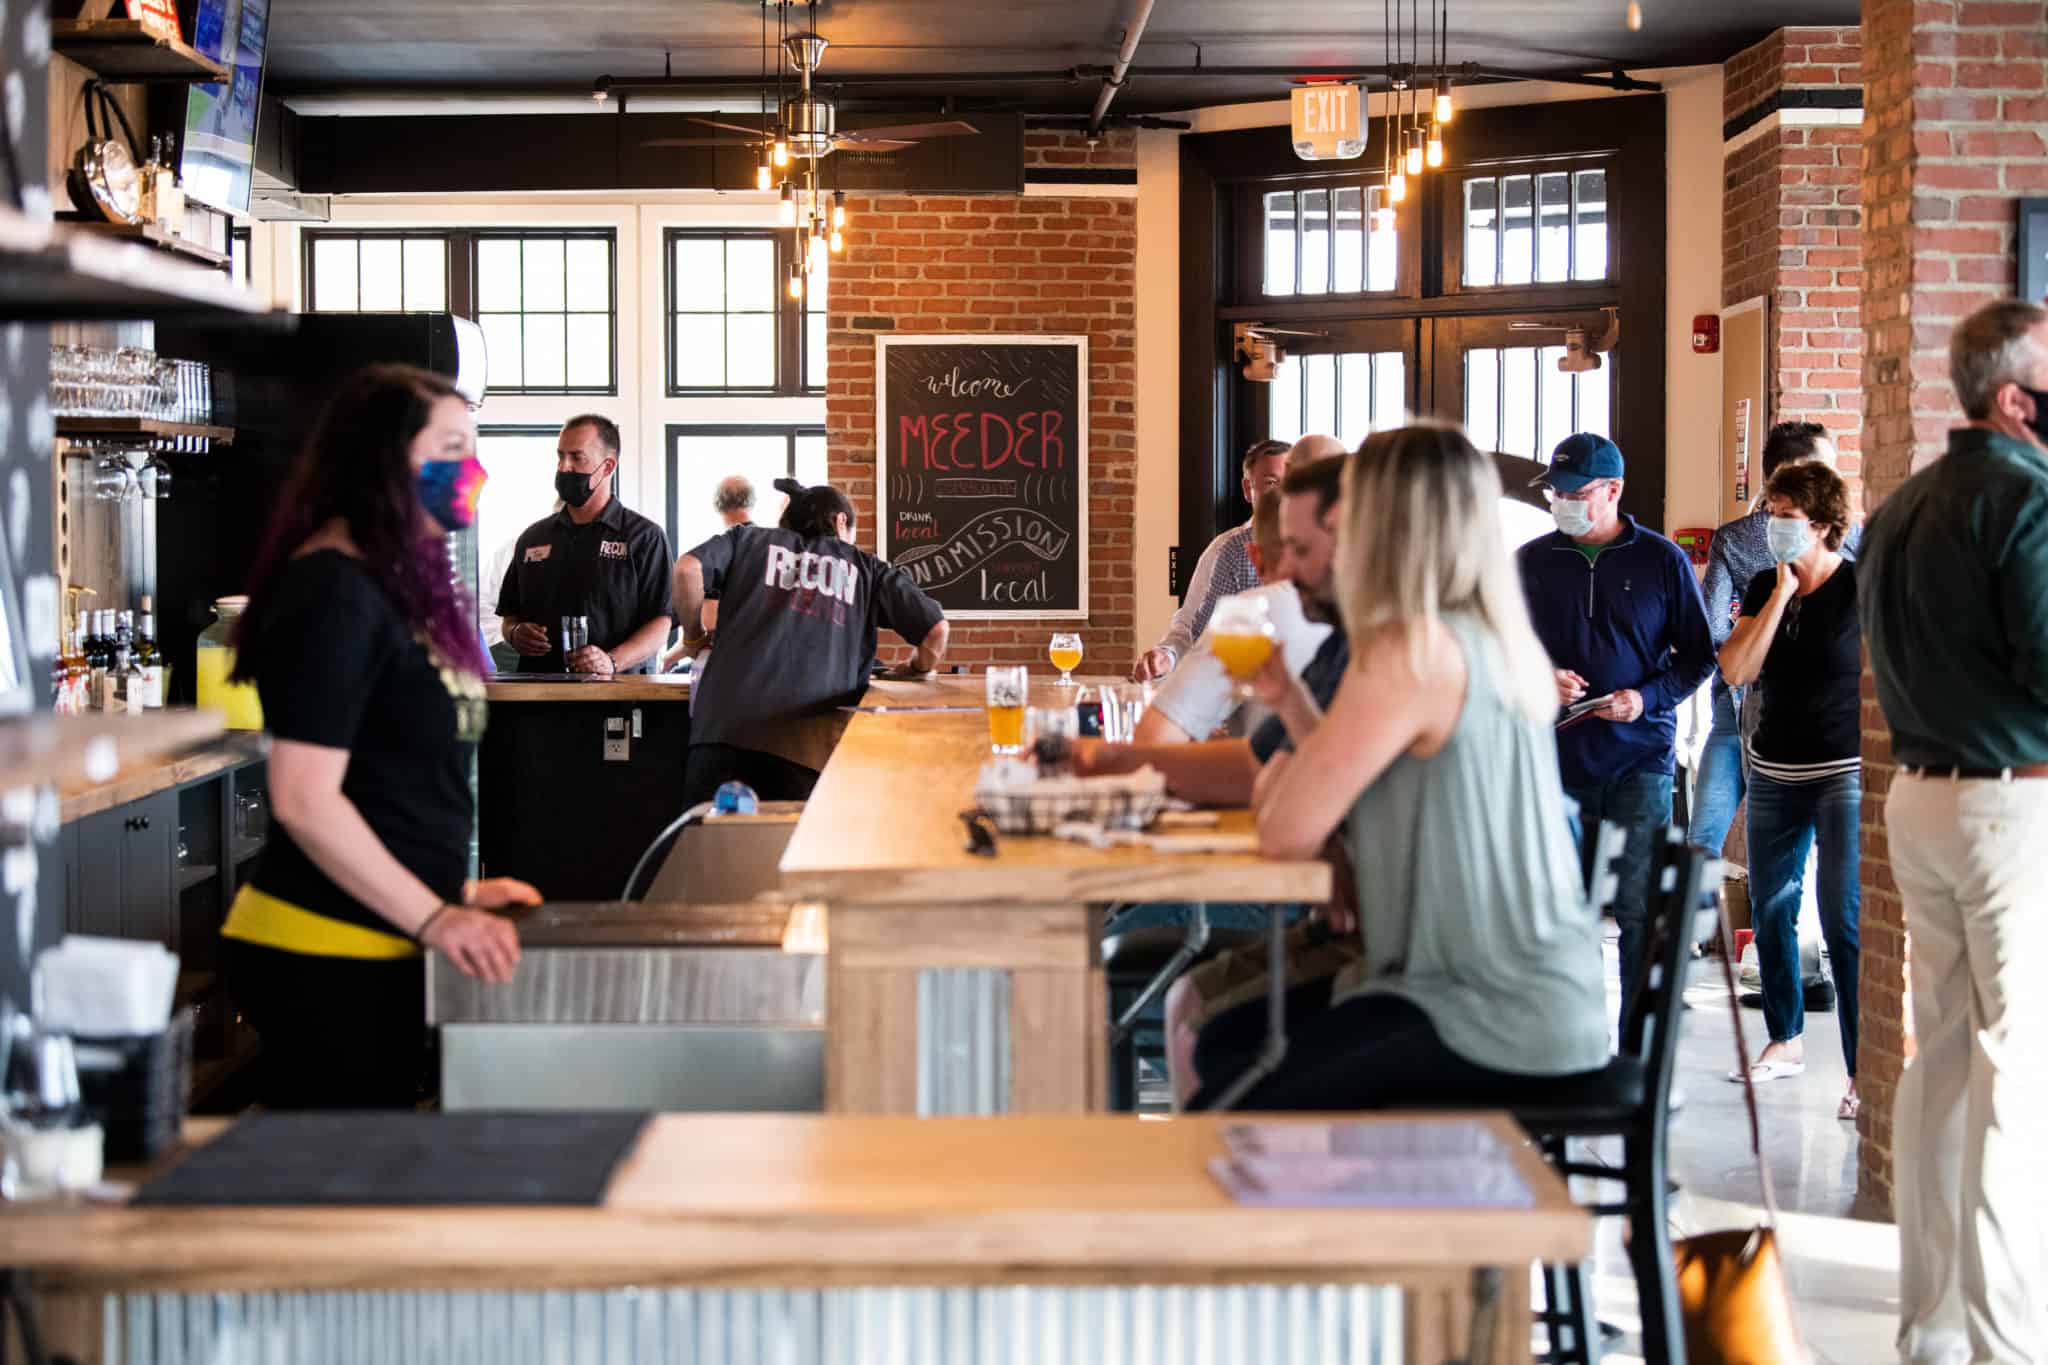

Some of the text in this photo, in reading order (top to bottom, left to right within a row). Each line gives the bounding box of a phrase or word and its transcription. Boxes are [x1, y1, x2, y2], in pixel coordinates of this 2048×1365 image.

[1304, 89, 1349, 132] EXIT
[920, 366, 1032, 398] welcome
[899, 410, 1063, 470] MEEDER
[899, 511, 934, 524] DRINK
[600, 540, 627, 556] RECON
[765, 543, 858, 606] RECON
